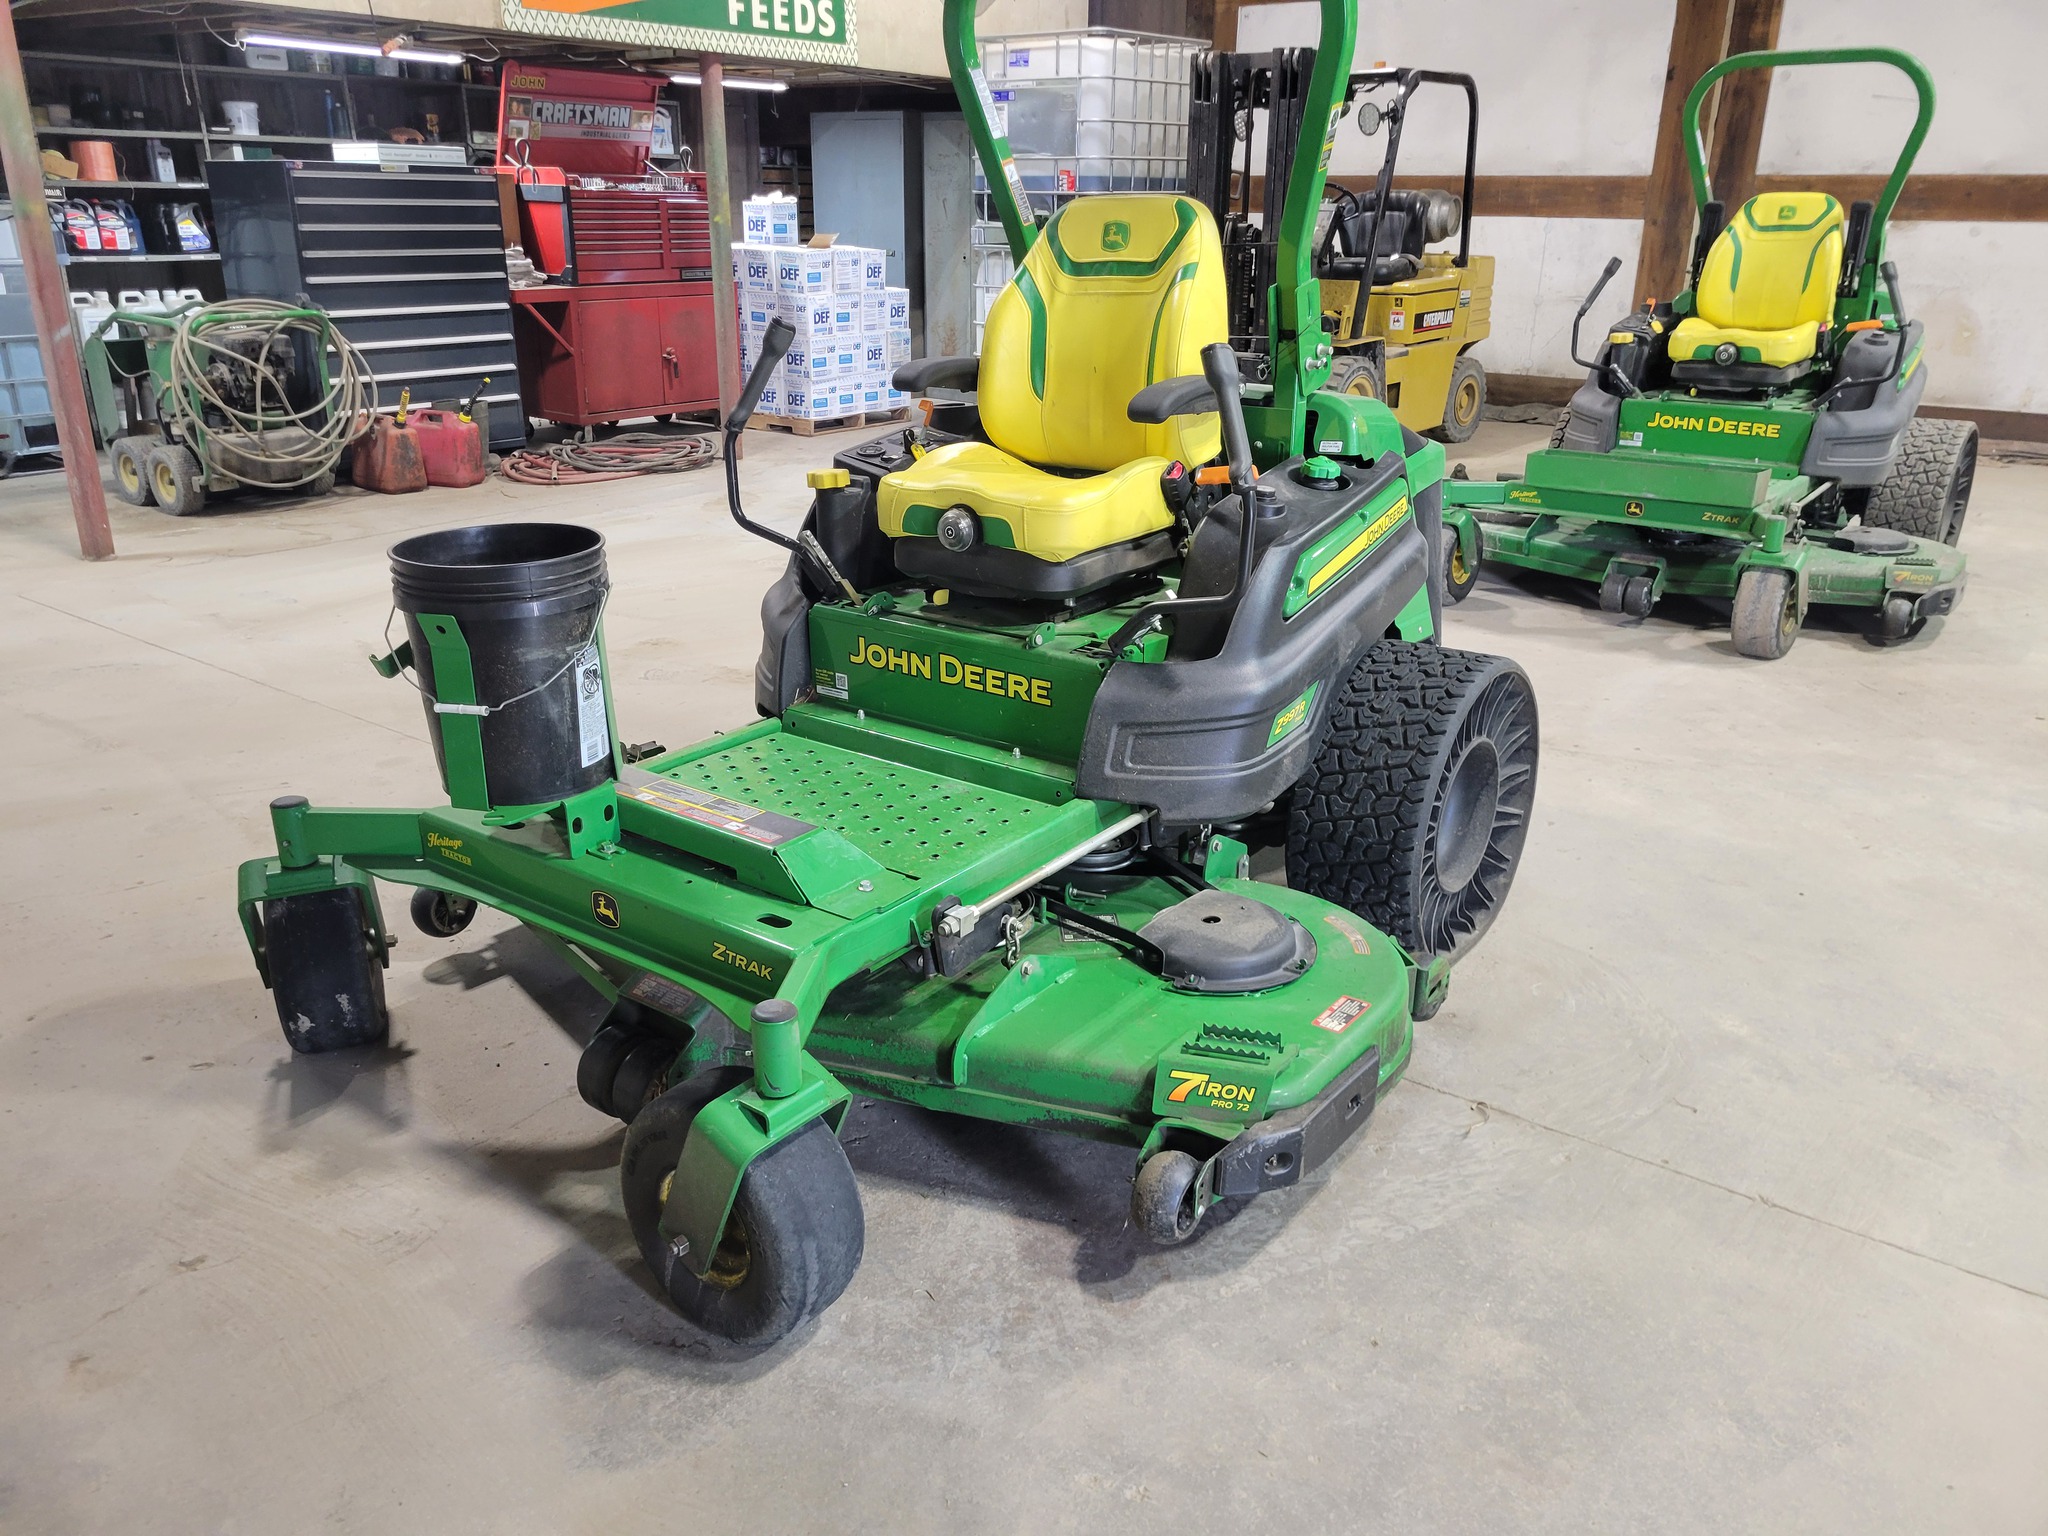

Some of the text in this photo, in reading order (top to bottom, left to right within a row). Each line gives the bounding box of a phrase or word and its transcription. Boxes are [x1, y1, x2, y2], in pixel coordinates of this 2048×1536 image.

[728, 0, 836, 37] FEEDS
[510, 75, 546, 89] JOHN
[532, 101, 631, 128] CRAFTSMAN
[748, 219, 766, 232] DEF
[748, 266, 768, 278] DEF
[780, 268, 799, 281] DEF
[866, 266, 882, 278] DEF
[796, 304, 806, 312] DEF
[891, 306, 905, 318] DEF
[814, 311, 830, 324] DEF
[1423, 310, 1454, 327] CATERPILLAR
[787, 353, 804, 366] DEF
[867, 348, 882, 361] DEF
[828, 386, 836, 394] DEF
[760, 391, 776, 403] DEF
[787, 394, 805, 406] DEF
[1647, 412, 1781, 438] JOHN DEERE
[1365, 502, 1405, 547] JOHN DEERE
[1702, 512, 1740, 524] ZTRAK
[849, 635, 1053, 707] JOHN DEERE
[1274, 699, 1306, 736] Z997R
[427, 832, 463, 850] Heritage
[711, 940, 774, 981] ZTRAK
[1210, 1099, 1251, 1112] PRO 72
